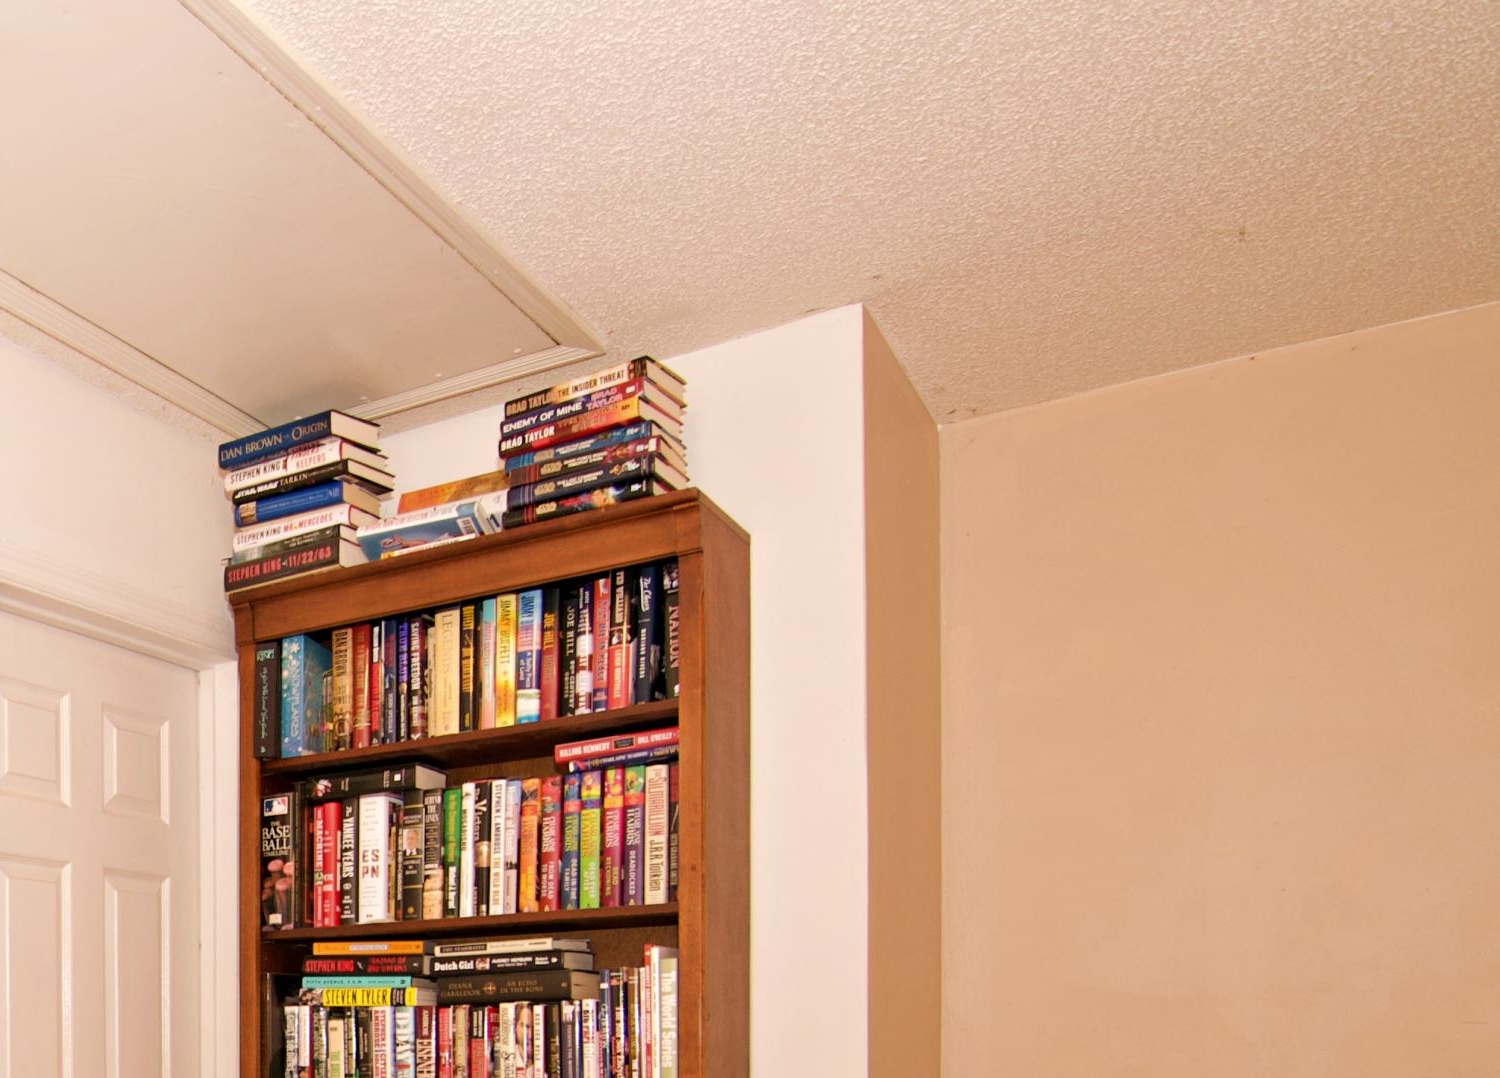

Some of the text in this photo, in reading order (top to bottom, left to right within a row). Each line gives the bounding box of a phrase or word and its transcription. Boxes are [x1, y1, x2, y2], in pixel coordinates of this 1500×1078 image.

[558, 369, 625, 396] THE INSIDER THREAT
[502, 416, 538, 433] ENEMY
[539, 411, 555, 422] OF
[556, 402, 583, 417] MINE
[506, 401, 528, 416] BRAD
[221, 433, 283, 461] DAN BROWN
[501, 425, 555, 452] BRAD TAYLOR
[230, 461, 281, 484] STEPHEN KING
[296, 453, 327, 469] KEEPERS
[280, 473, 309, 487] TARKIN
[236, 512, 333, 545] STEPHEN KING MERCEDES
[227, 565, 261, 584] STEPHEN
[262, 559, 281, 574] KING
[521, 595, 535, 618] JIMMY
[615, 571, 625, 624] TED WILLIAMS
[499, 599, 511, 628] JIMMY
[334, 631, 348, 647] DAN
[441, 613, 454, 675] LEGENDS
[543, 613, 555, 650] JOE HILL
[566, 606, 575, 657] JOE HILL
[334, 650, 348, 678] BROWN
[398, 622, 408, 683] TRUE BLUE
[410, 622, 422, 690] SAVING FREEDOM
[288, 660, 301, 738] SNOWFLAKES
[559, 746, 582, 758] KILLING
[583, 742, 610, 754] KENNEDY
[426, 805, 437, 814] THE
[493, 784, 503, 814] STEPHEN
[262, 825, 292, 840] BASE
[493, 821, 502, 855] AMBROSE
[541, 817, 551, 853] HARRIS
[605, 810, 614, 848] HARRIS
[626, 807, 636, 846] HARRIS
[262, 839, 292, 852] BALL
[315, 820, 324, 868] MACHINE
[342, 817, 355, 878] YANKEE YEARS
[649, 840, 666, 862] J.R.R.
[541, 863, 548, 873] TO
[548, 861, 556, 900] FROM DEAD
[563, 867, 571, 892] FAMILY
[604, 857, 612, 897] RECKONING
[628, 850, 636, 896] DEADLOCKED
[649, 862, 665, 892] Tolkien
[304, 959, 354, 973] STEPHEN KING
[434, 959, 474, 972] Dutch Girl
[325, 987, 388, 1005] STEVEN TYLER
[440, 989, 481, 997] GABALDON
[449, 982, 473, 990] DIANA
[525, 985, 544, 993] BONE
[661, 971, 677, 1068] The World Series
[550, 1036, 559, 1052] The
